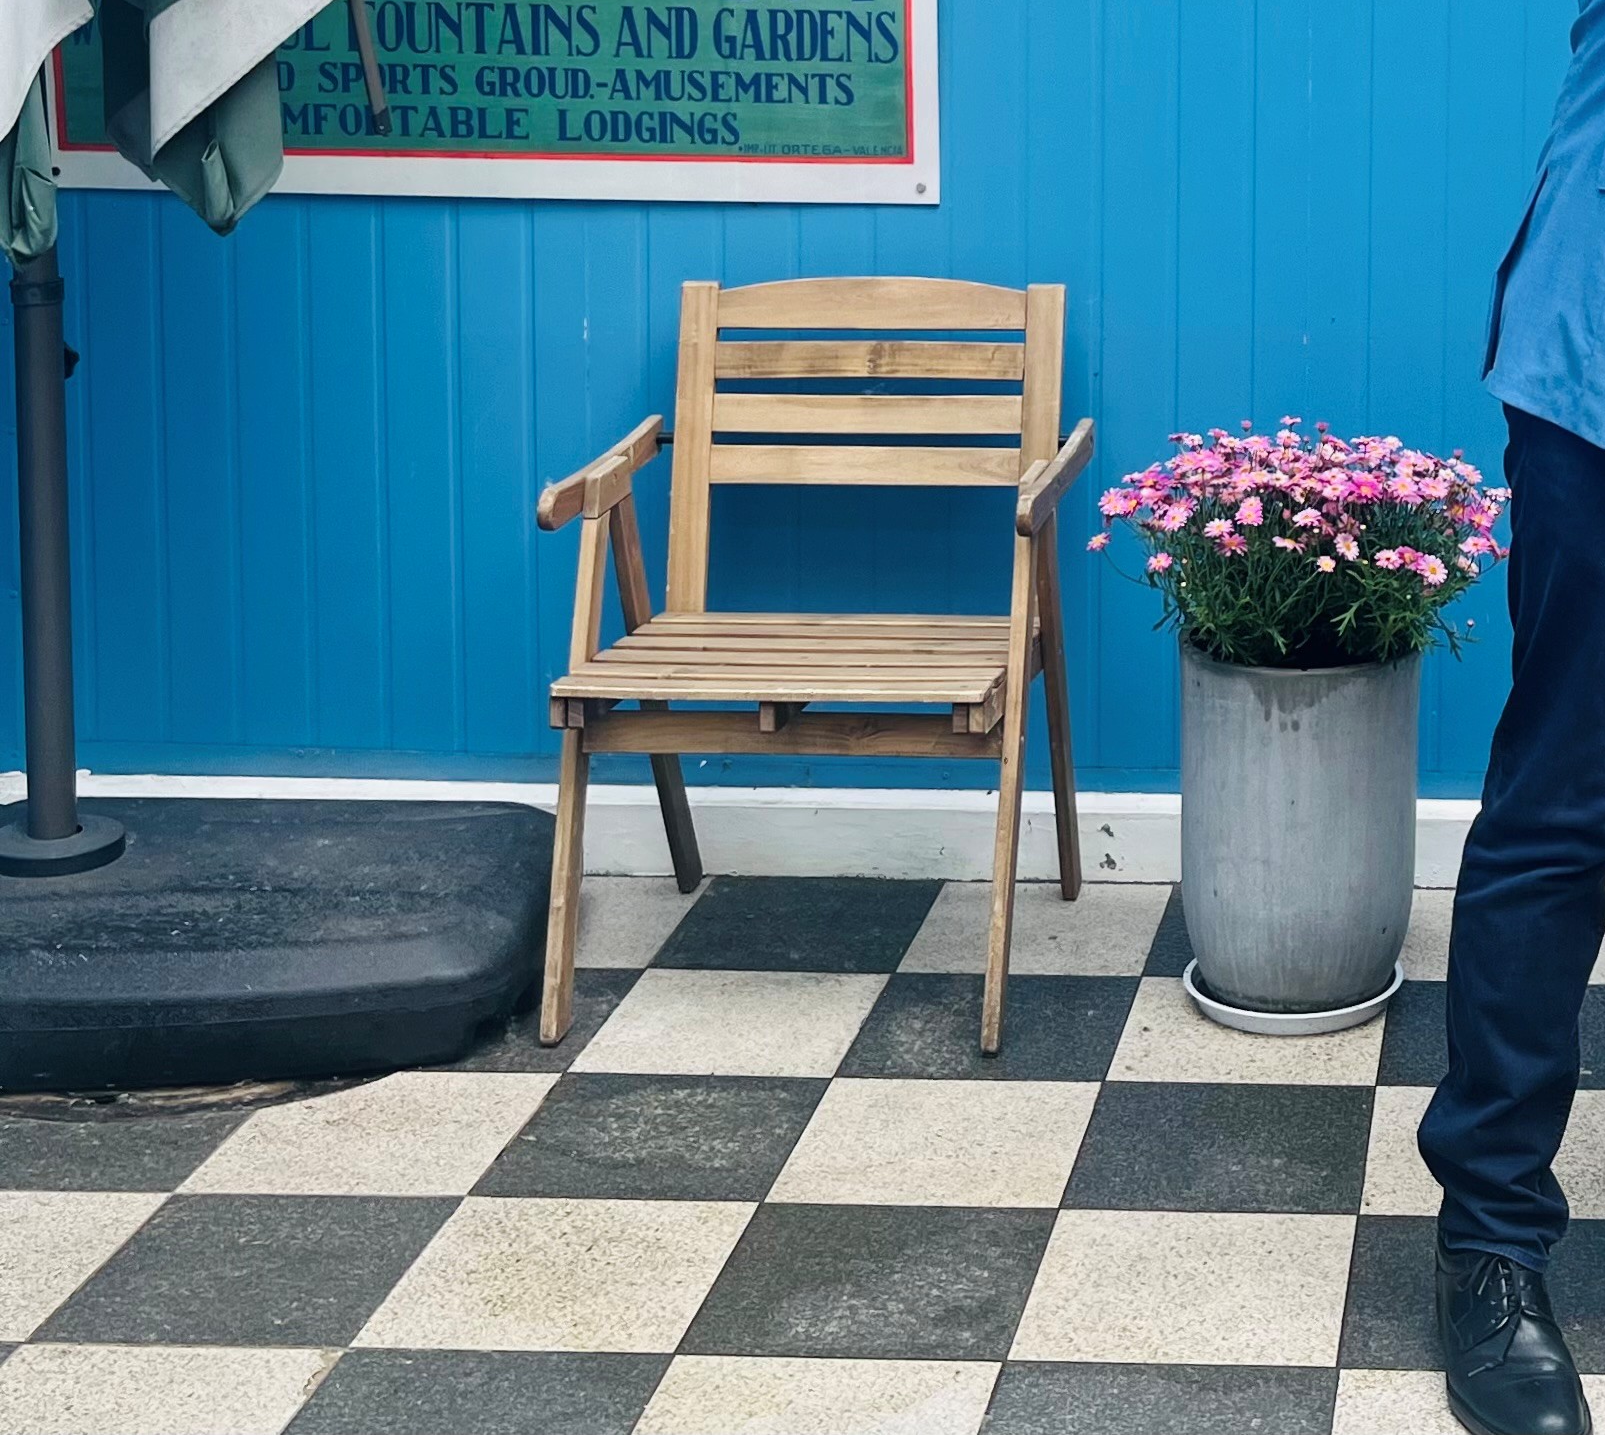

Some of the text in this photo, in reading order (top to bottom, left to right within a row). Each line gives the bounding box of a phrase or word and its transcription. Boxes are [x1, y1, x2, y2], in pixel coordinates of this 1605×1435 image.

[613, 5, 699, 60] AND
[712, 7, 900, 65] GARDENS
[282, 102, 741, 146] MFOTABLE LODGINGS
